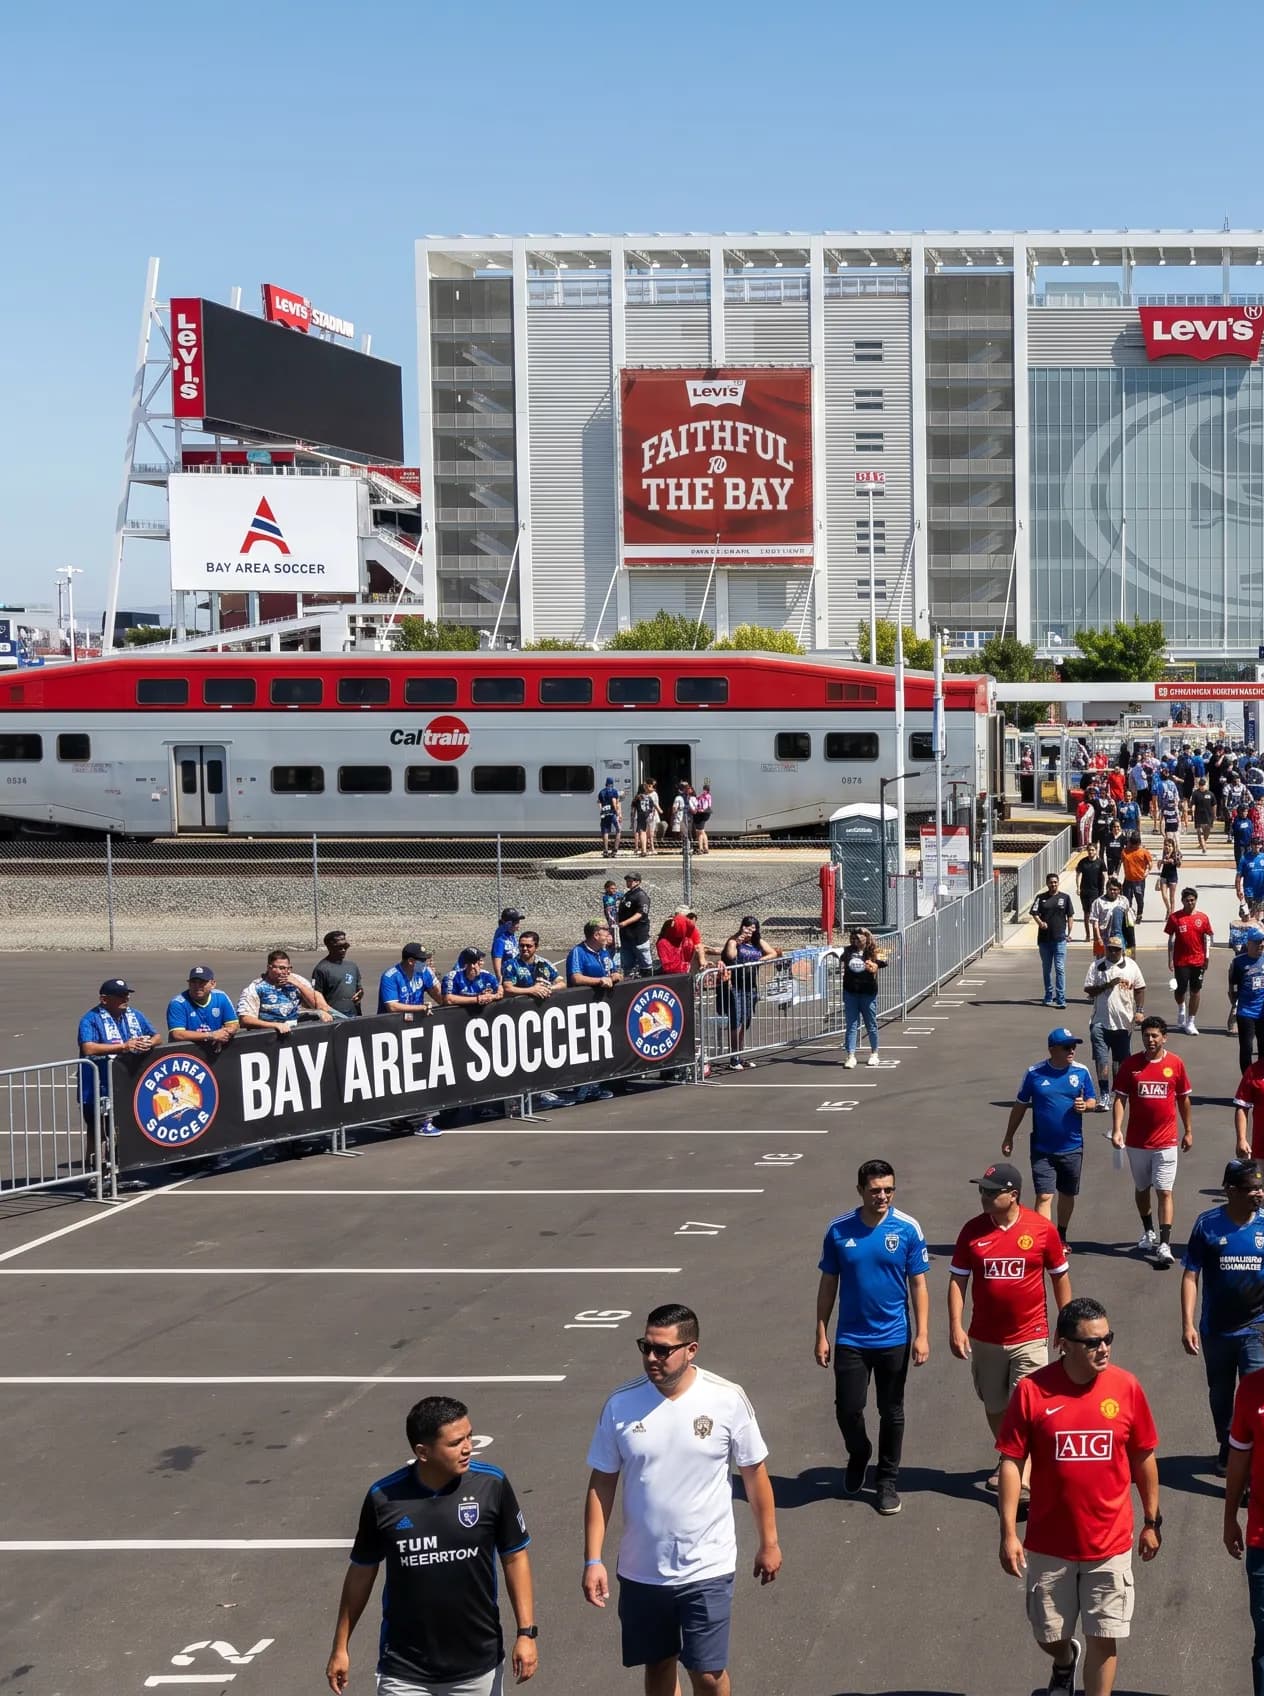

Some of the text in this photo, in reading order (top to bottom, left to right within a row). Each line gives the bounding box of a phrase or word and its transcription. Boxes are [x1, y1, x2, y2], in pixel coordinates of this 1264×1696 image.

[1152, 317, 1254, 341] Levi's
[641, 419, 794, 474] FAITHFUL
[641, 477, 795, 511] THE BAY
[206, 562, 326, 575] BAY AREA SOCCER
[390, 729, 471, 746] Caltrain
[240, 1001, 614, 1122] BAY AREA SOCCER
[145, 1060, 206, 1091] BAY AREA
[987, 1259, 1022, 1277] AIG
[1059, 1433, 1109, 1457] AIG
[144, 1638, 275, 1687] 12
